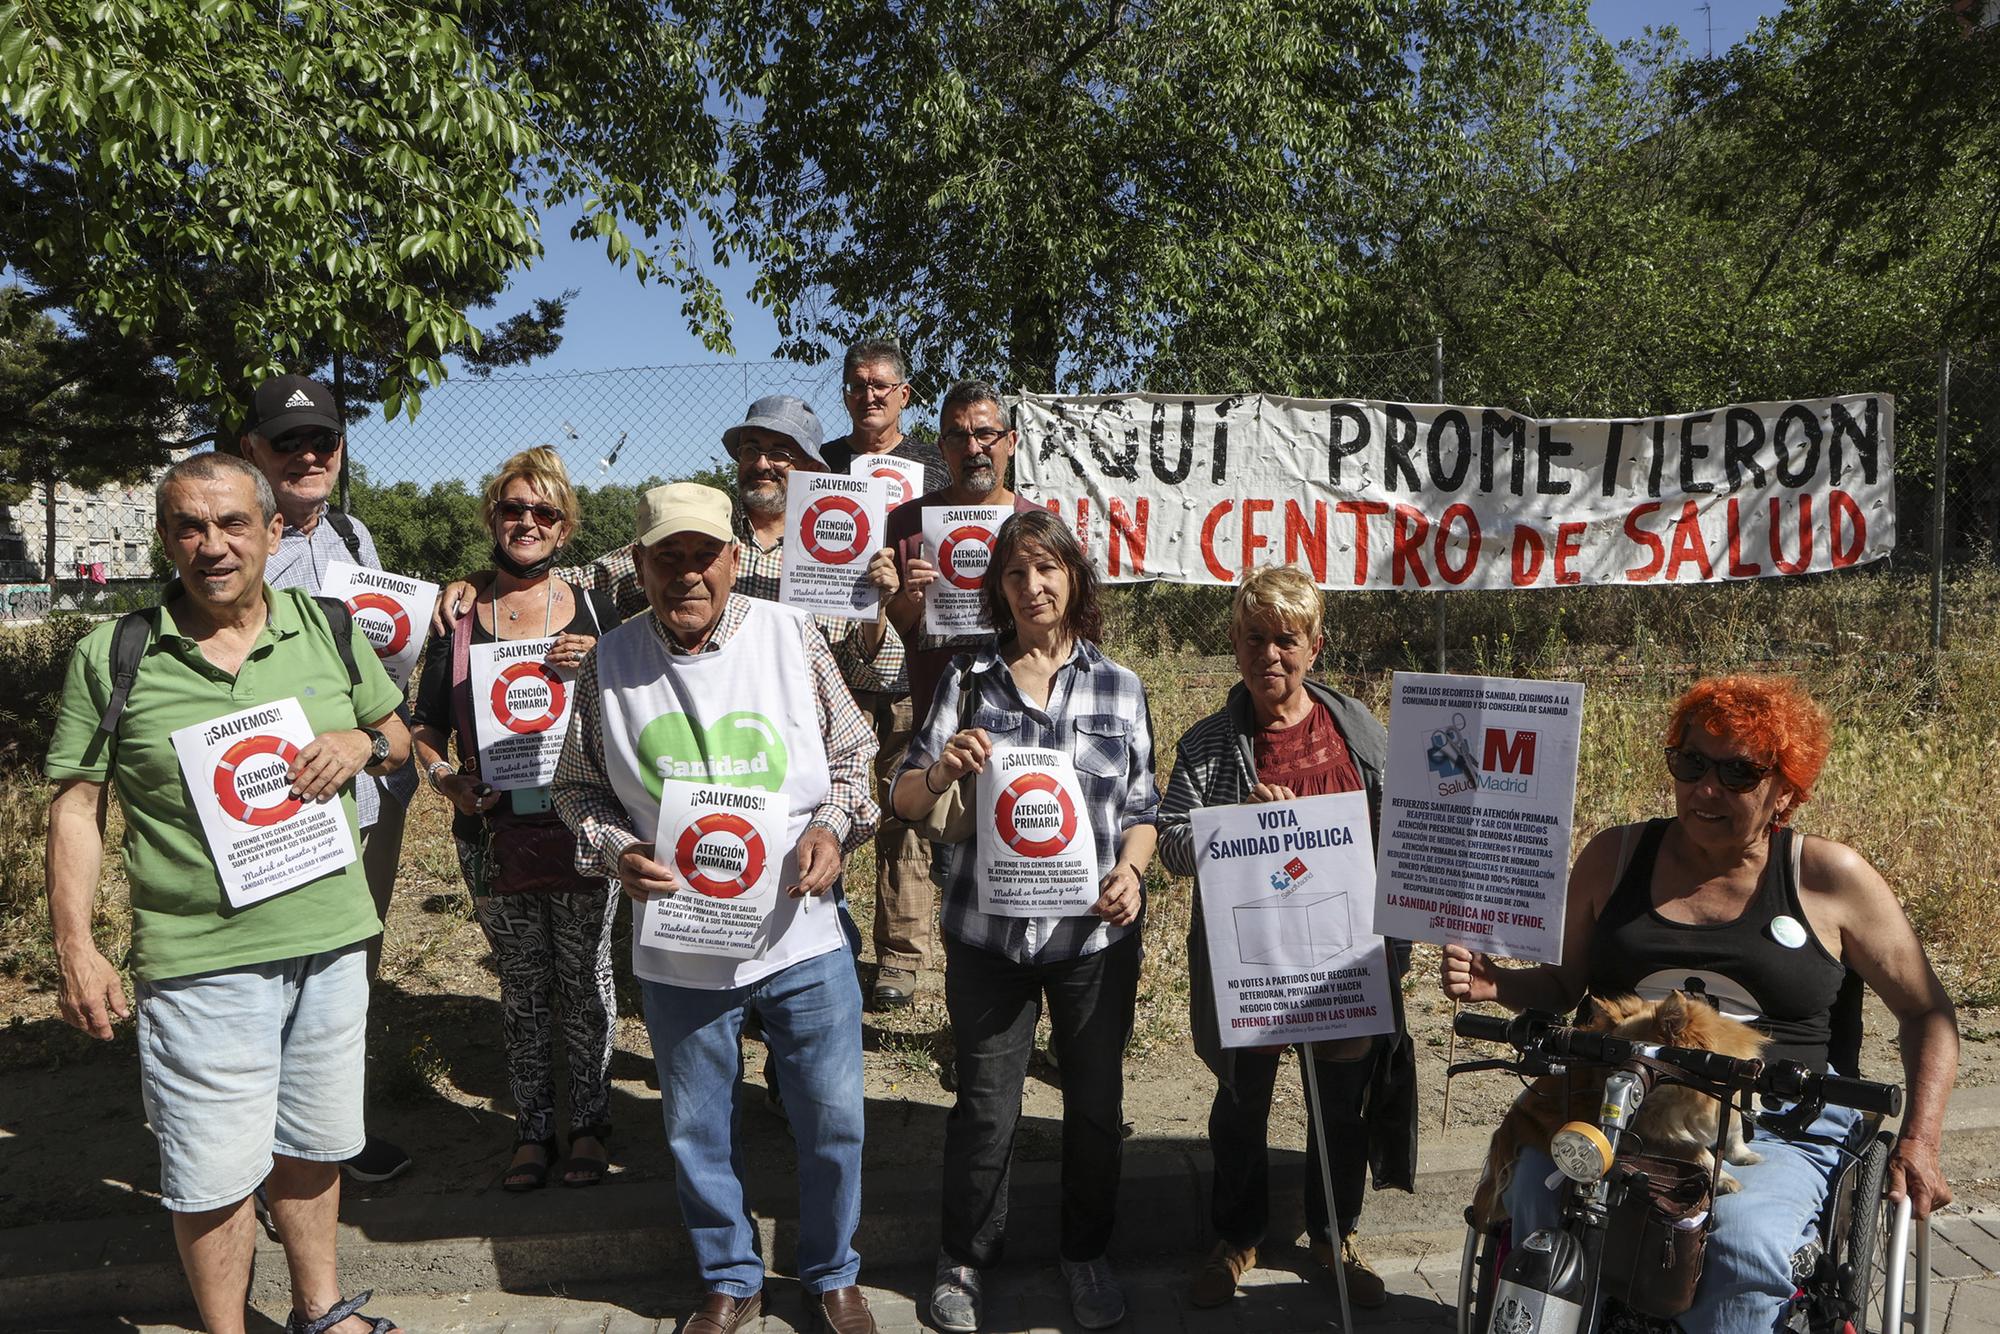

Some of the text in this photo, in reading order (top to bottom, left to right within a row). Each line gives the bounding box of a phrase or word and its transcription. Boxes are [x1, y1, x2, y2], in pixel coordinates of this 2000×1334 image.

[285, 400, 314, 408] adidas
[1039, 394, 1243, 485] AQUÍ
[810, 478, 868, 493] ¡¡SALVEMOS!!
[816, 517, 854, 531] ATENCIÓN
[942, 510, 998, 524] ¡¡SALVEMOS!!
[816, 532, 852, 542] PRIMARIA
[1200, 498, 1481, 588] CENTRO
[1511, 522, 1587, 586] DE
[1624, 490, 1866, 581] SALUD
[952, 546, 988, 559] ATENCIÓN
[952, 559, 988, 568] PRIMARIA
[350, 572, 416, 596] ¡¡SALVEMOS!!
[354, 617, 394, 634] TENCIÓN
[362, 630, 389, 643] MARIA
[508, 684, 548, 700] ATENCIÓN
[1402, 685, 1427, 694] CONTRA
[1428, 687, 1440, 695] LOS
[1441, 687, 1474, 698] RECORTES
[1475, 690, 1484, 698] EN
[1485, 690, 1517, 702] SANIDAD,
[1518, 693, 1552, 703] EXIGIMOS
[1561, 696, 1569, 705] LA
[508, 698, 549, 710] PRIMARIA
[1402, 696, 1438, 706] COMUNIDAD
[1448, 699, 1471, 708] MADRID
[1478, 701, 1487, 710] SU
[1488, 702, 1527, 713] CONSEJERÍA
[1528, 705, 1537, 713] DE
[1538, 706, 1568, 716] SANIDAD
[204, 708, 283, 745] ¡¡SALVEMOS!!
[1002, 753, 1060, 770] ¡¡SALVEMOS!!
[1482, 728, 1536, 775] M
[236, 761, 287, 787] ATENCIÓN
[656, 752, 768, 778] Sanidad
[239, 776, 290, 801] PRIMARIA
[1477, 774, 1528, 793] Madrid
[690, 790, 766, 810] ¡¡SALVEMOS!!
[1014, 801, 1059, 816] ATENCIÓN
[1257, 809, 1298, 829] VOTA
[1392, 797, 1558, 825] REFUERZOS SANITARIOS EN ATENCIÓN PRIMARIA
[232, 811, 326, 850] DEFIENDE TUS CENTROS DE SALUD
[1014, 817, 1060, 829] PRIMARIA
[1397, 819, 1548, 846] ATENCIÓN PRESENCIAL SIN DEMORAS ABUSIVAS
[1406, 810, 1446, 822] REAPERTURA
[1447, 814, 1455, 823] DE
[1456, 815, 1474, 825] SUAP
[1481, 818, 1495, 828] SAR
[1496, 820, 1511, 830] CON
[1513, 822, 1547, 835] MEDIC@S
[227, 816, 336, 861] DE ATENCIÓN PRIMARIA, SUS URGENCIAS
[1209, 827, 1353, 859] SANIDAD PÚBLICA
[1392, 830, 1427, 842] ASIGNACIÓN
[1428, 835, 1436, 843] DE
[1437, 836, 1466, 847] MEDIC@S,
[1467, 839, 1510, 852] ENFERMER@S
[1518, 846, 1552, 858] PEDIATRAS
[696, 844, 744, 860] ATENCIÓN
[1401, 842, 1539, 867] ATENCIÓN PRIMARIA SIN RECORTES DE HORARIO
[694, 856, 742, 872] PRIMARIA
[1398, 861, 1538, 888] DINERO PÚBLICO PARA SANIDAD 100% PÚBLICA
[1391, 870, 1545, 899] DEDICAR 25% DEL GASTO TOTAL EN ATENCIÓN PRIMARIA
[1403, 883, 1529, 908] RECUPERAR LOS CONSEJOS DE SALUD DE ZONA
[1387, 893, 1546, 931] LA SANIDAD PÚBLICA NO SE VENDE,
[1429, 915, 1493, 935] ¡¡SE DEFIENDE!!
[1227, 980, 1239, 989] NO
[1240, 977, 1264, 988] VOTES
[1272, 973, 1309, 985] PARTIDOS
[1310, 971, 1326, 981] QUE
[1327, 967, 1370, 979] RECORTAN,
[1239, 988, 1286, 1001] DETERIORAN,
[1287, 984, 1329, 996] PRIVATIZAN
[1336, 980, 1361, 991] HACEN
[1239, 993, 1364, 1014] NEGOCIO CON LA SANIDAD PÚBLICA
[1231, 1005, 1376, 1029] DEFIENDE TU SALUD EN LAS URNAS
